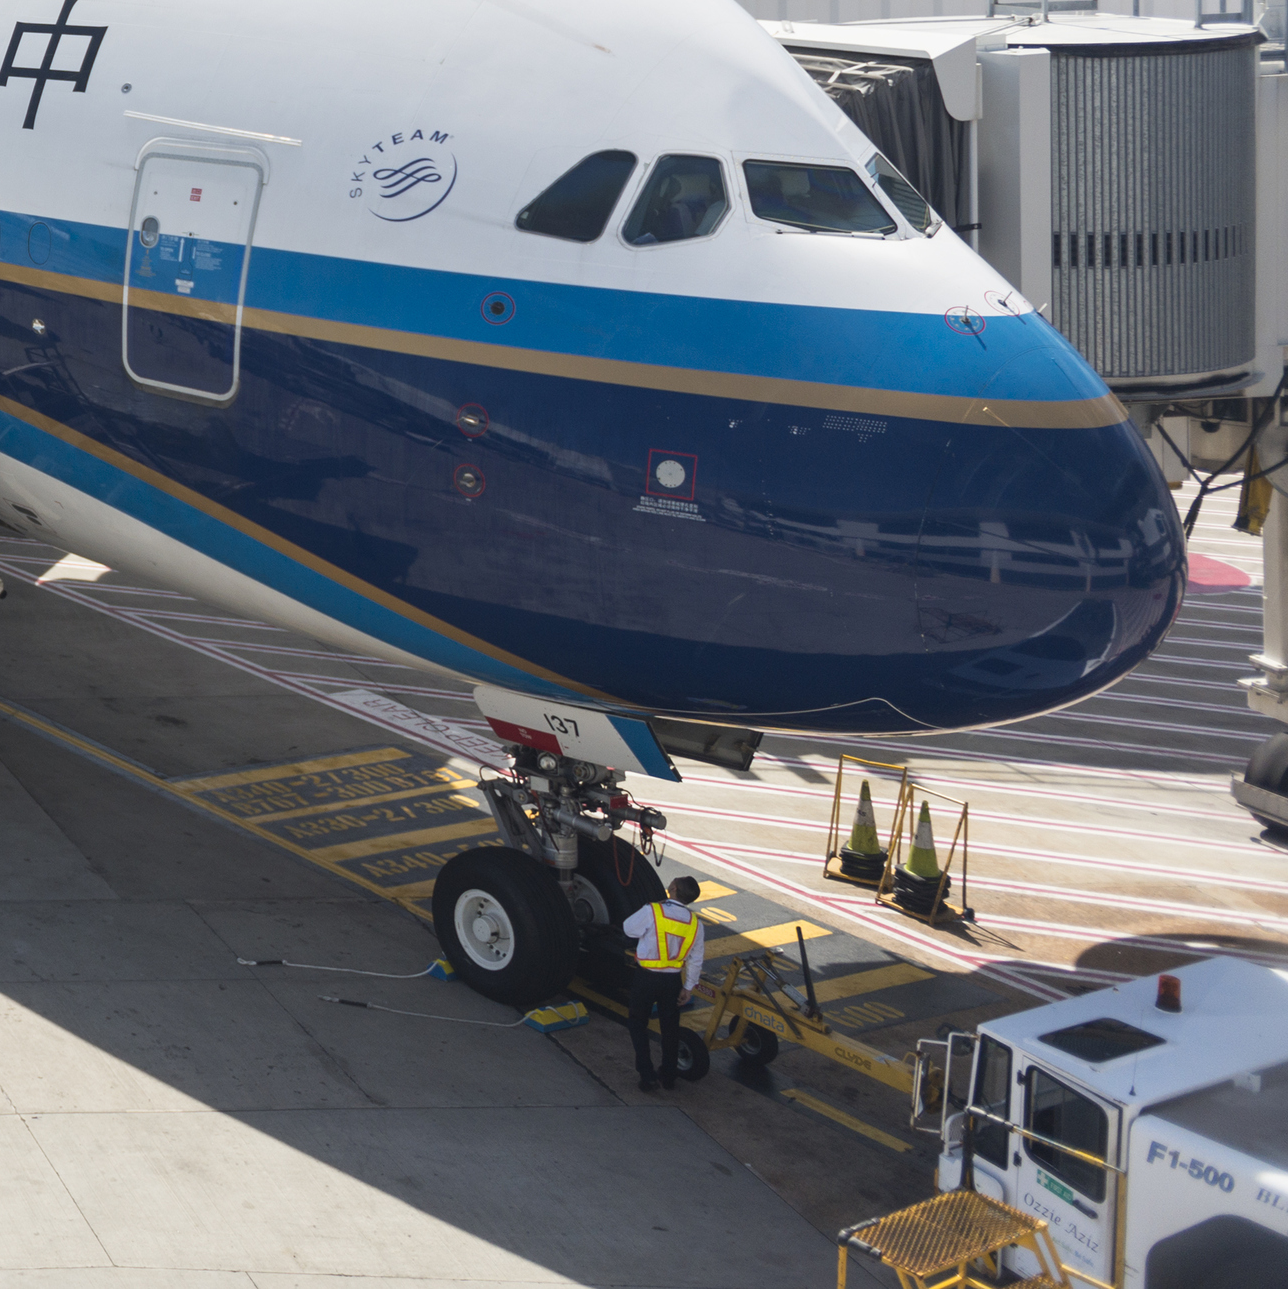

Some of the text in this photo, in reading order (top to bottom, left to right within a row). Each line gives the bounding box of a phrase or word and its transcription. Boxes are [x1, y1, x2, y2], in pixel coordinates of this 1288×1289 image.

[349, 129, 449, 199] SKYTEAM
[363, 698, 451, 734] CLEAR
[543, 713, 580, 738] 137
[696, 984, 714, 998] A380
[744, 1005, 785, 1034] dnata
[834, 1046, 873, 1071] CLYDE
[1146, 1140, 1235, 1194] F1-500
[1256, 1187, 1288, 1212] BL
[1023, 1192, 1062, 1226] Ozzie
[1064, 1222, 1099, 1253] Aziz
